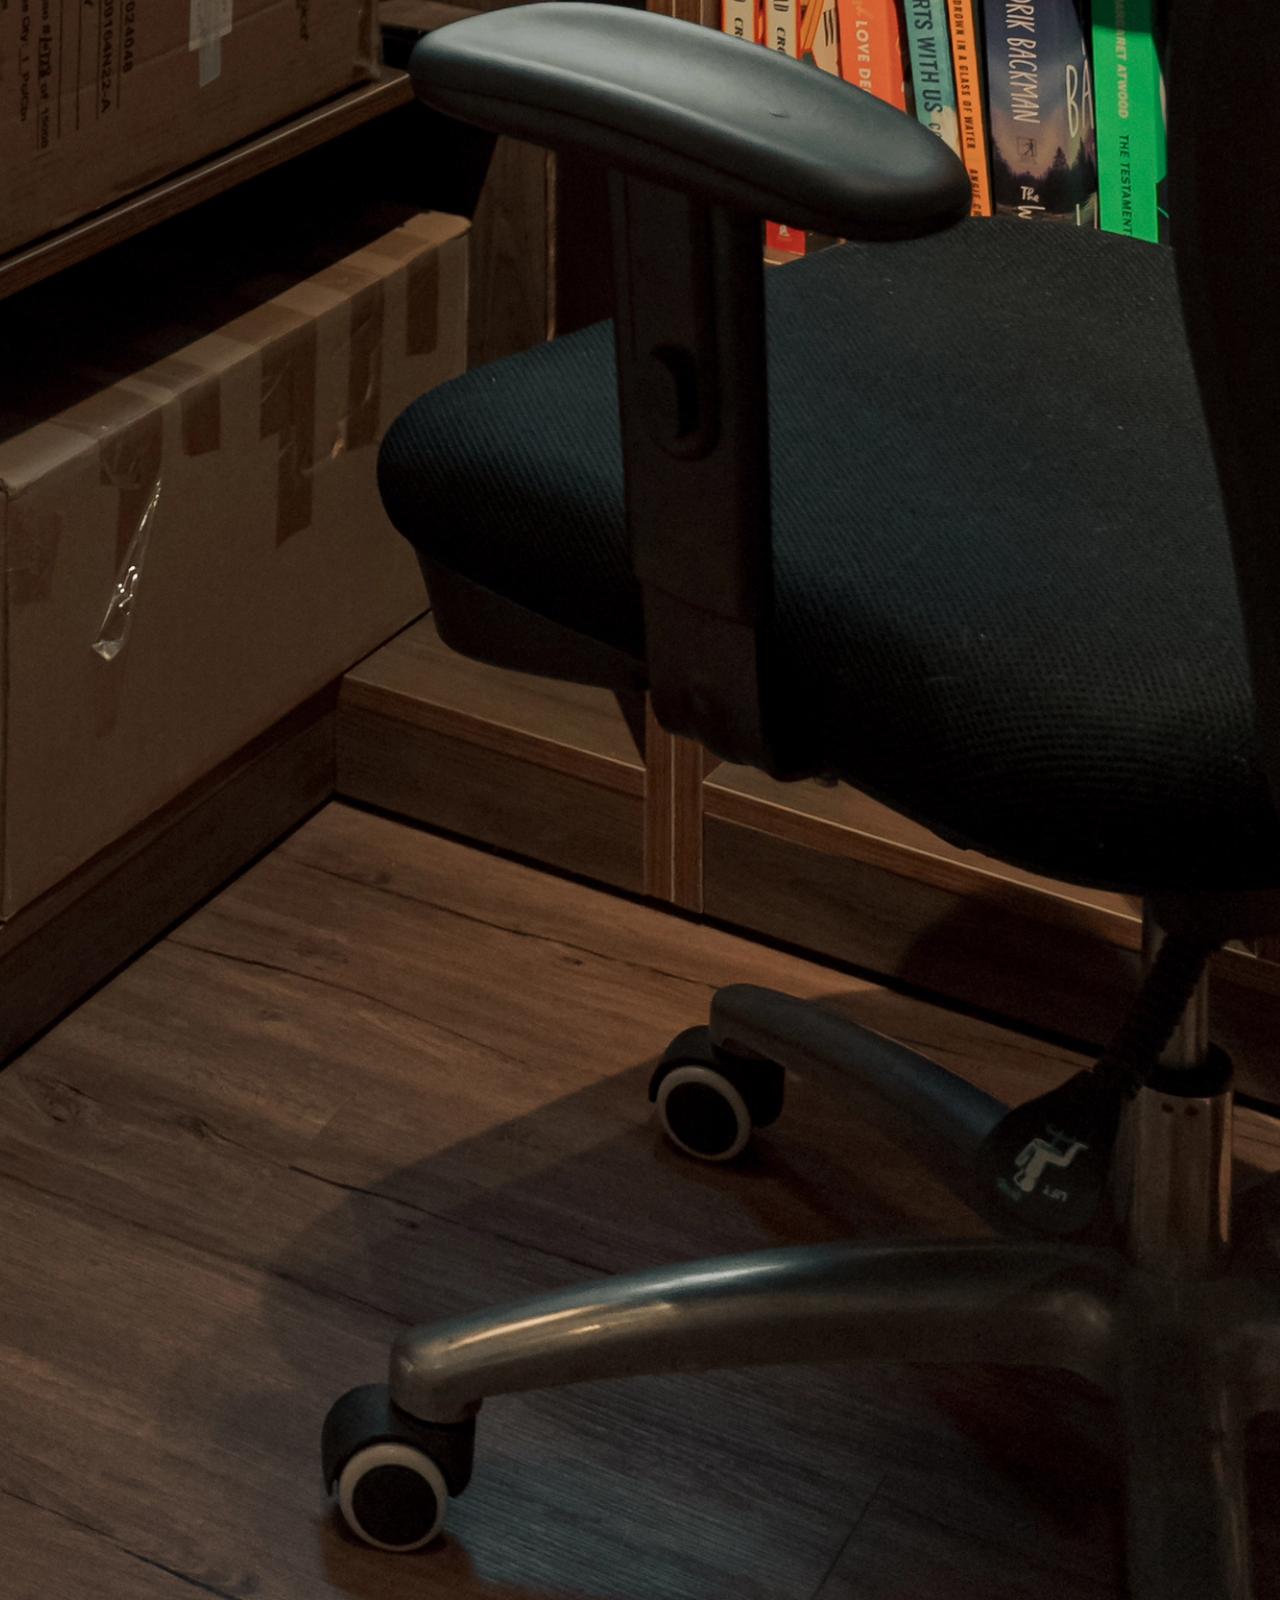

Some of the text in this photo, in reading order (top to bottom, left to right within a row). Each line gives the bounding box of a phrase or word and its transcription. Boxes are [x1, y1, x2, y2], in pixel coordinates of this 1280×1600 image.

[854, 19, 871, 64] LOVE
[916, 36, 940, 86] WITH
[922, 89, 943, 114] US
[1006, 37, 1041, 125] BACKMAN
[1118, 135, 1130, 160] THE
